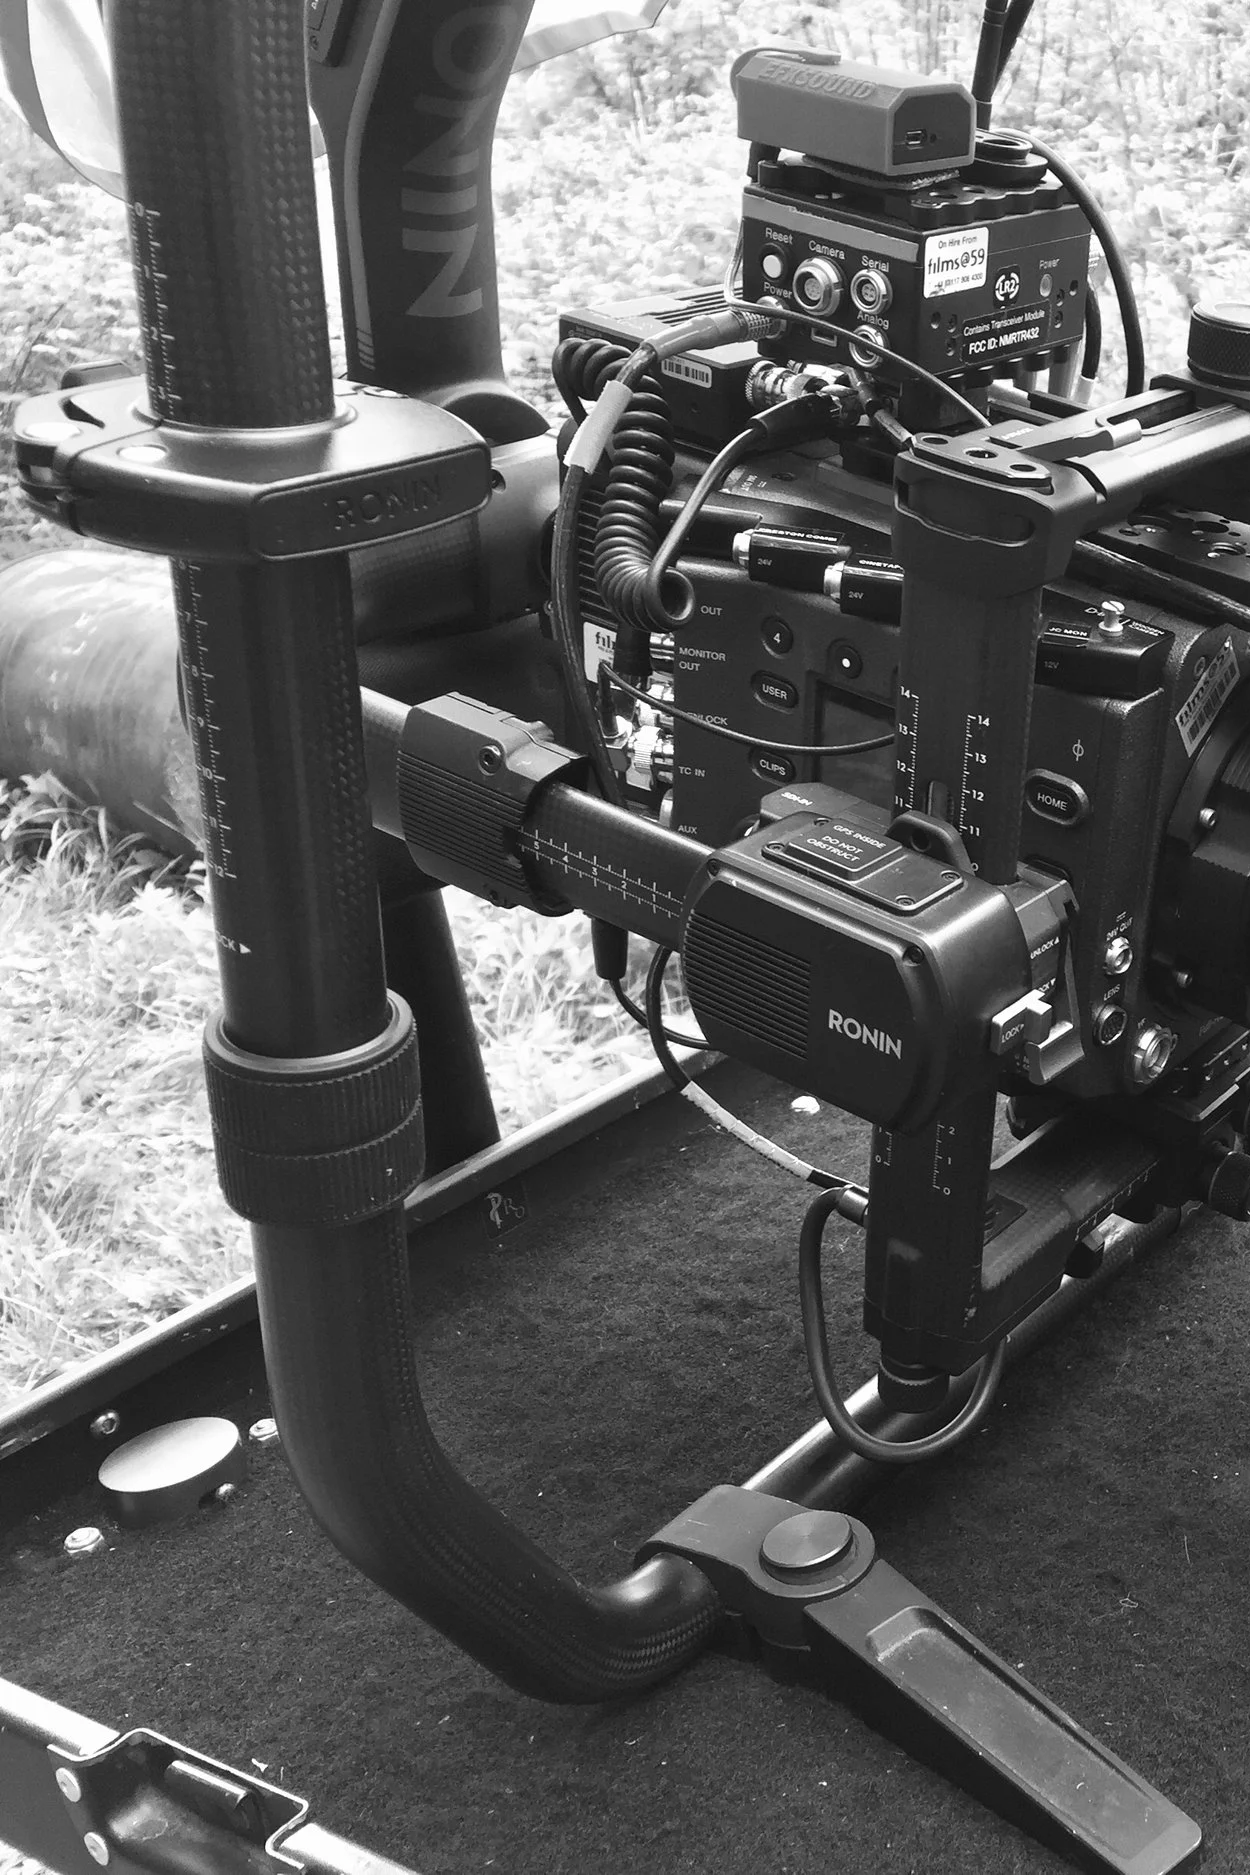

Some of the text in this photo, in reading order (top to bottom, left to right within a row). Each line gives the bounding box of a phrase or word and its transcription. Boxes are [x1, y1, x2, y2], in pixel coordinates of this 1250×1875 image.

[765, 227, 793, 244] Reset
[938, 236, 978, 249] On Hire From
[809, 240, 845, 260] Camera
[861, 255, 890, 273] Serial
[928, 248, 985, 275] films@59
[1039, 258, 1060, 269] Power
[763, 281, 793, 299] Power
[1000, 280, 1015, 294] LR2
[856, 310, 890, 330] Analog
[963, 309, 1045, 337] Contains Transceiver Module
[968, 340, 986, 355] FCC
[987, 338, 998, 350] ID:
[757, 558, 773, 566] 24V
[849, 591, 864, 600] 24V
[700, 605, 722, 616] OUT
[773, 632, 781, 644] 4
[679, 647, 726, 662] MONITOR
[679, 661, 701, 671] OUT
[762, 683, 788, 700] USER
[900, 686, 910, 699] 14
[978, 715, 990, 727] 14
[898, 723, 908, 735] 13
[975, 752, 987, 764] 13
[678, 766, 706, 778] TC IN
[759, 759, 786, 776] CLIPS
[896, 760, 906, 772] 12
[895, 796, 903, 807] 11
[972, 789, 985, 801] 12
[1037, 792, 1068, 811] HOME
[677, 825, 697, 835] AUX
[833, 825, 887, 849] GPS INSIDE
[969, 825, 980, 837] 11
[807, 838, 860, 862] OBSTRUCT
[822, 836, 864, 854] DO NOT
[534, 841, 540, 850] 5
[562, 855, 569, 863] 4
[591, 866, 598, 875] 3
[621, 881, 627, 890] 2
[1030, 940, 1055, 960] UNLOCK
[1103, 984, 1121, 1001] LENS
[828, 1008, 902, 1060] RONIN
[1001, 1026, 1021, 1044] LOCK
[948, 1126, 956, 1136] 2
[943, 1187, 951, 1196] 0
